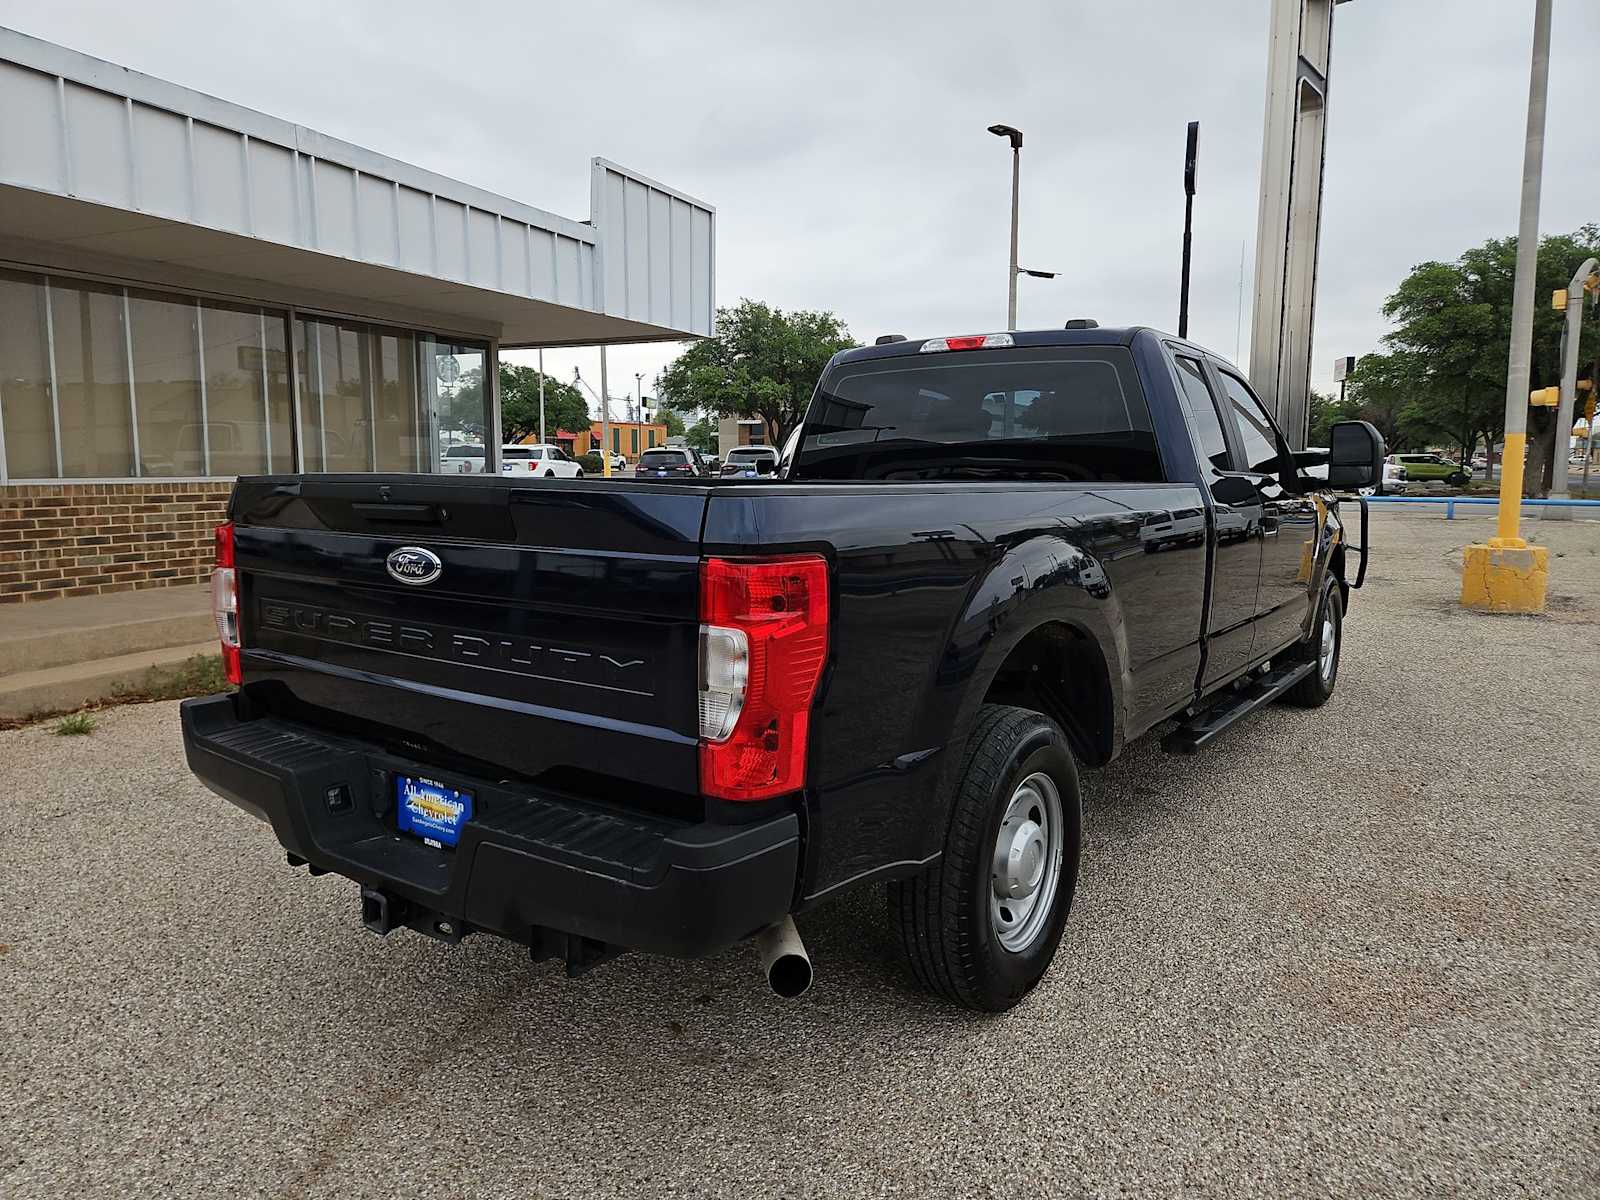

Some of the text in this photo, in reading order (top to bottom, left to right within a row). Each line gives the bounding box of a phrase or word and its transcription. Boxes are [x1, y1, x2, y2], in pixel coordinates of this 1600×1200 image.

[396, 553, 425, 576] Ford
[264, 605, 645, 675] SUPER DUTY
[404, 784, 464, 812] All American
[411, 802, 457, 825] Chevrolet
